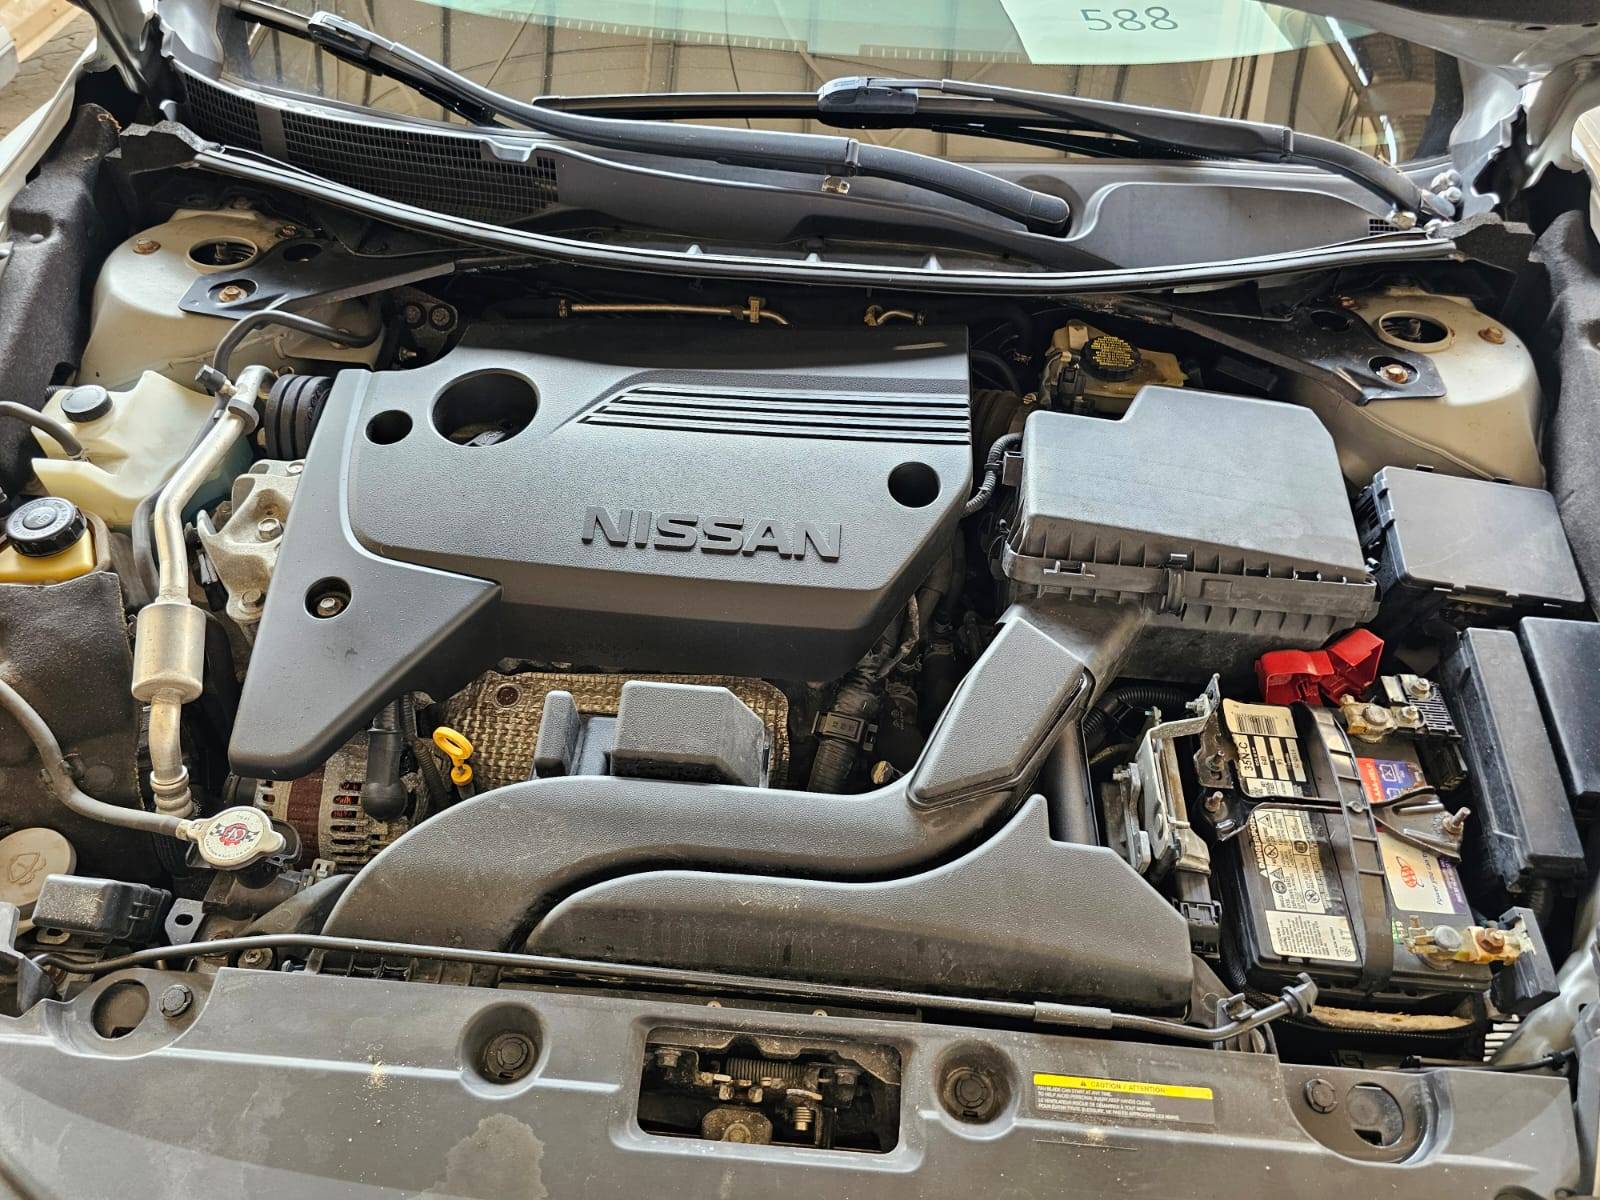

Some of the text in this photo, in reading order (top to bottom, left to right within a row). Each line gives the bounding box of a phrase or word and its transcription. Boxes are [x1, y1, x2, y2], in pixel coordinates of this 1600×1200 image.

[1080, 6, 1178, 31] 588
[581, 504, 842, 563] NISSAN
[1238, 741, 1254, 771] 35N-C
[1090, 1081, 1121, 1090] CAUTION
[1128, 1085, 1166, 1094] ATTENTION
